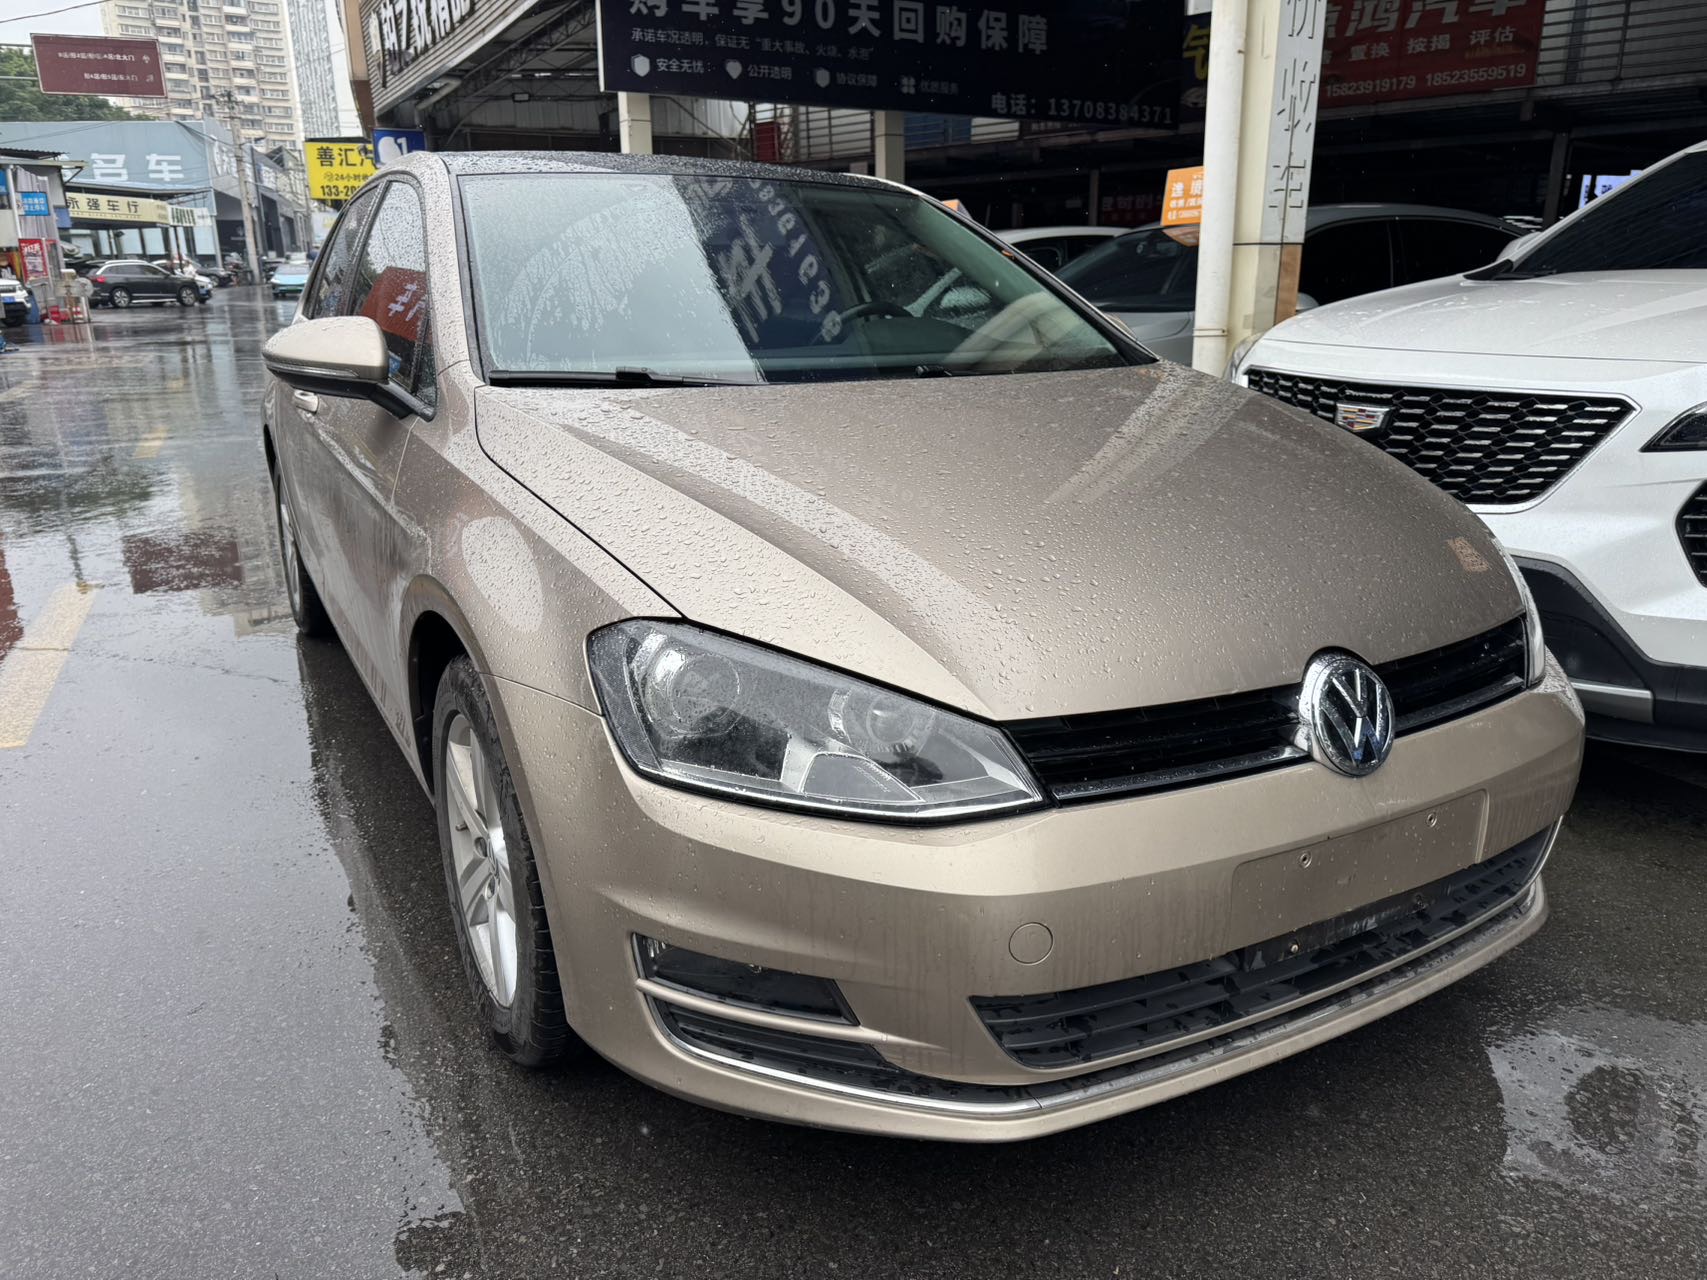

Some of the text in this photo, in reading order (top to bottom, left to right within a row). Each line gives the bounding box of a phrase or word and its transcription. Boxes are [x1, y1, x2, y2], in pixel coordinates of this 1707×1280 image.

[1407, 34, 1452, 55] 按揭
[1468, 26, 1518, 47] 评估
[655, 57, 705, 75] 安全无忧
[1325, 64, 1527, 99] 15823919179 18523559519
